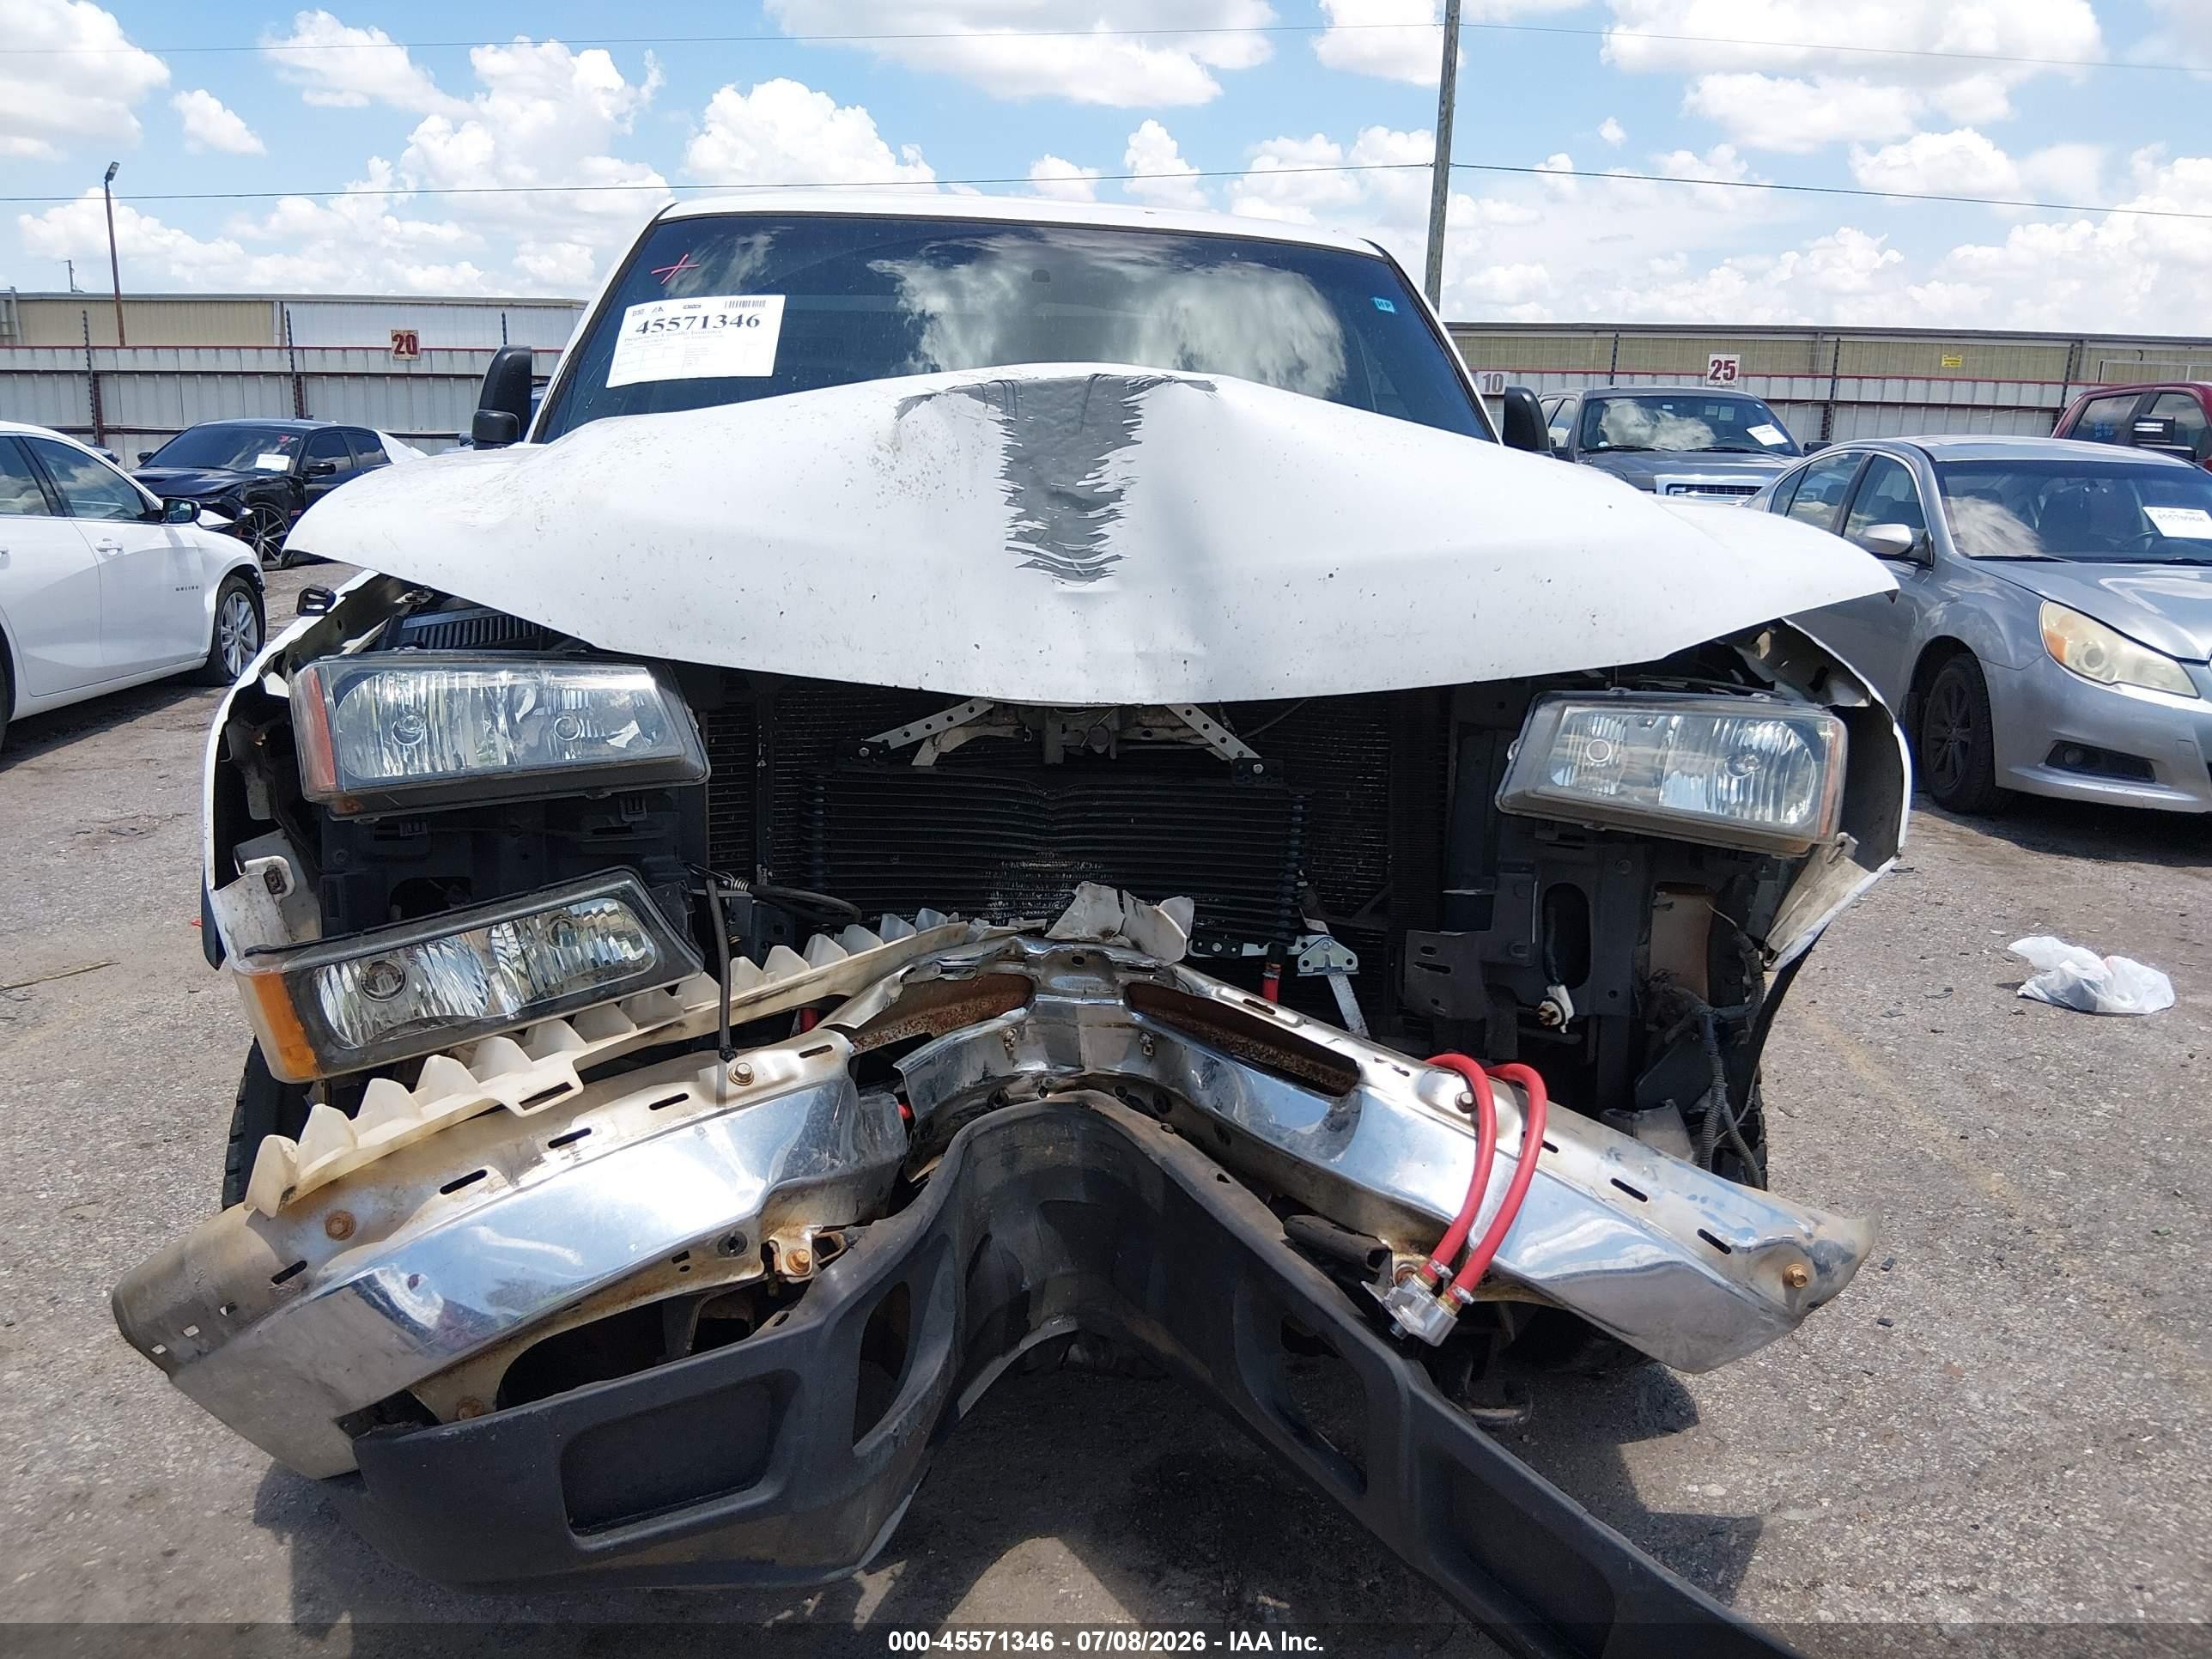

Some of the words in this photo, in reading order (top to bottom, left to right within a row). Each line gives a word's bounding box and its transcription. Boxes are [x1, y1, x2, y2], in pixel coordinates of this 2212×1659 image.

[635, 313, 761, 334] 45571346
[392, 333, 418, 356] 20
[1710, 359, 1736, 382] 25
[1483, 373, 1504, 393] 10
